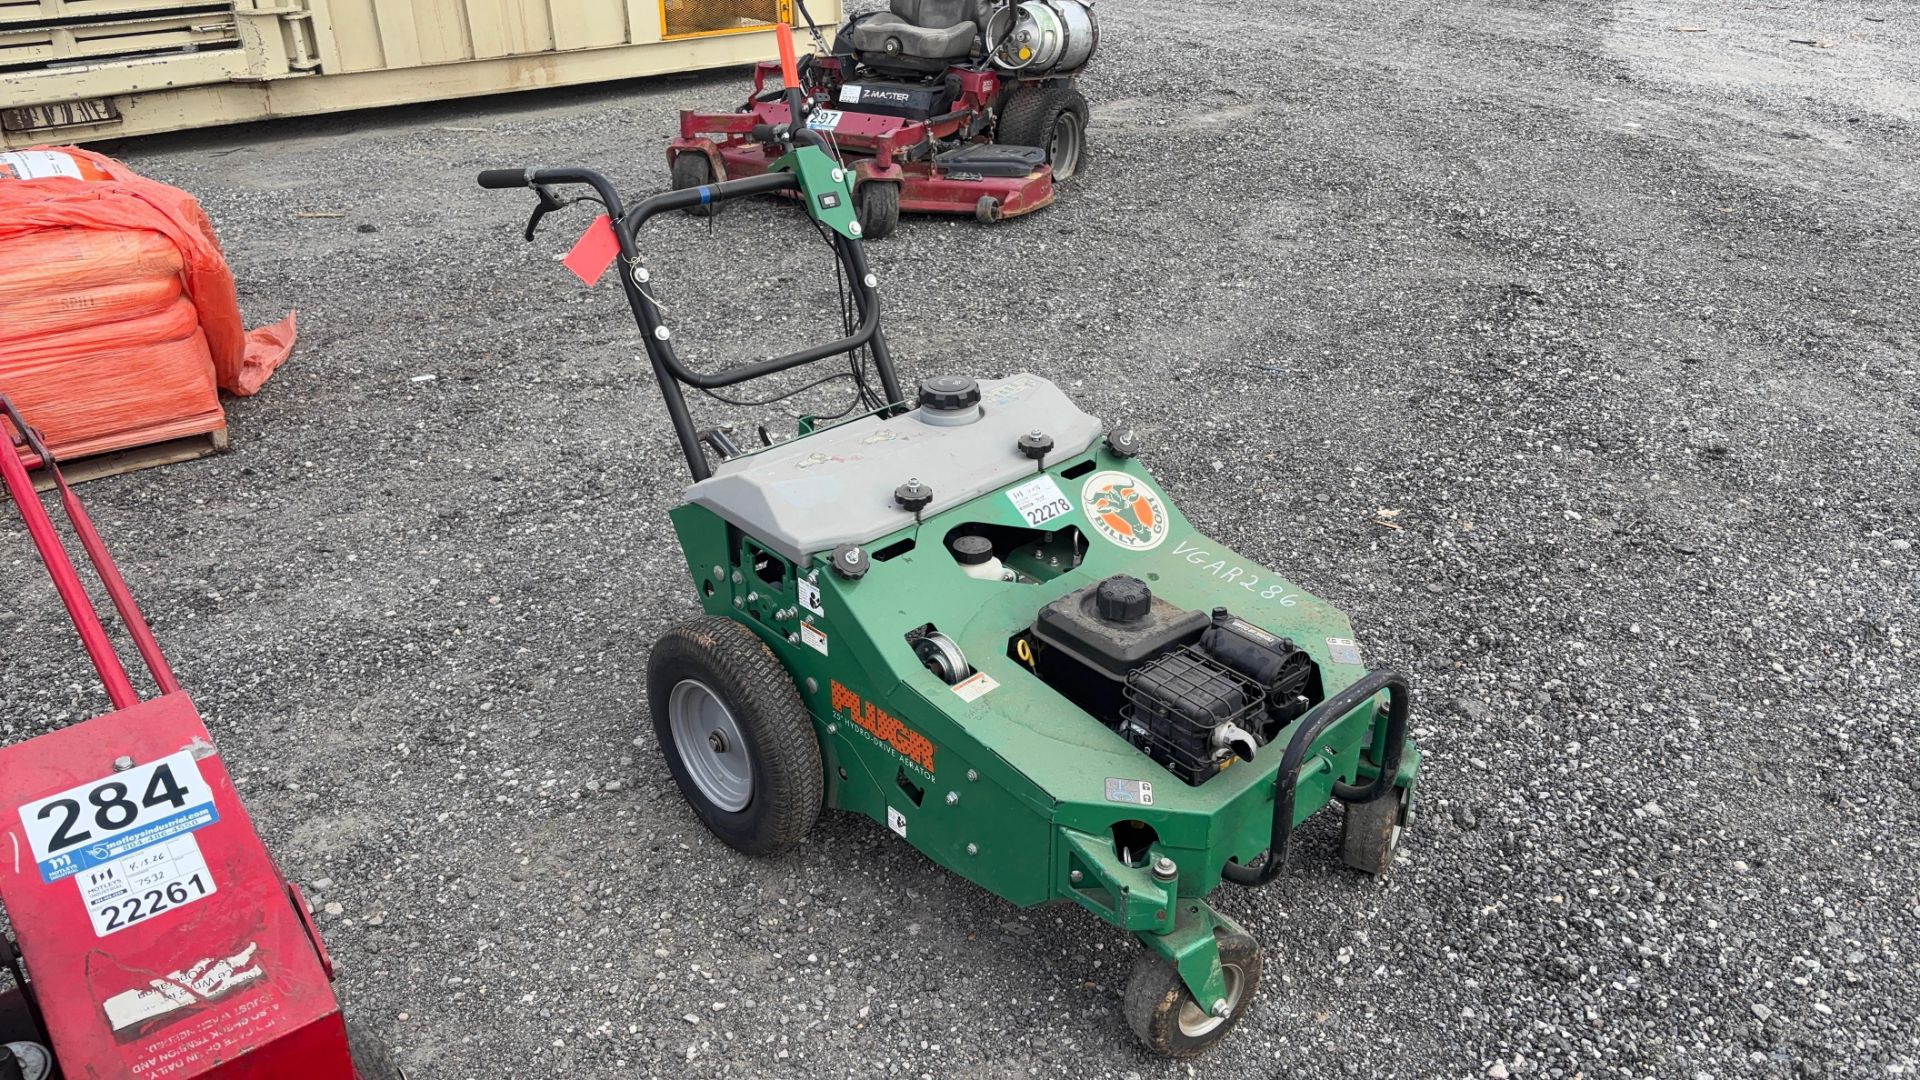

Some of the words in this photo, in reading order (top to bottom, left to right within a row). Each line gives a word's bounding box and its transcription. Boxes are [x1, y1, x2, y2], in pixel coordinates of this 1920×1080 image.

[871, 90, 909, 102] MASTER
[810, 110, 838, 125] 297
[1027, 498, 1070, 525] 22278
[1095, 516, 1137, 545] BILLY
[1149, 497, 1163, 534] GOAT
[1172, 540, 1299, 608] VGAR286
[844, 718, 896, 758] HYDRO-DRIVE
[899, 755, 936, 783] AERATOR
[37, 763, 190, 853] 284
[106, 808, 209, 850] motleysindustrial.com
[87, 879, 122, 895] MOTLEYS
[101, 873, 206, 932] 22261
[132, 1058, 157, 1074] AND
